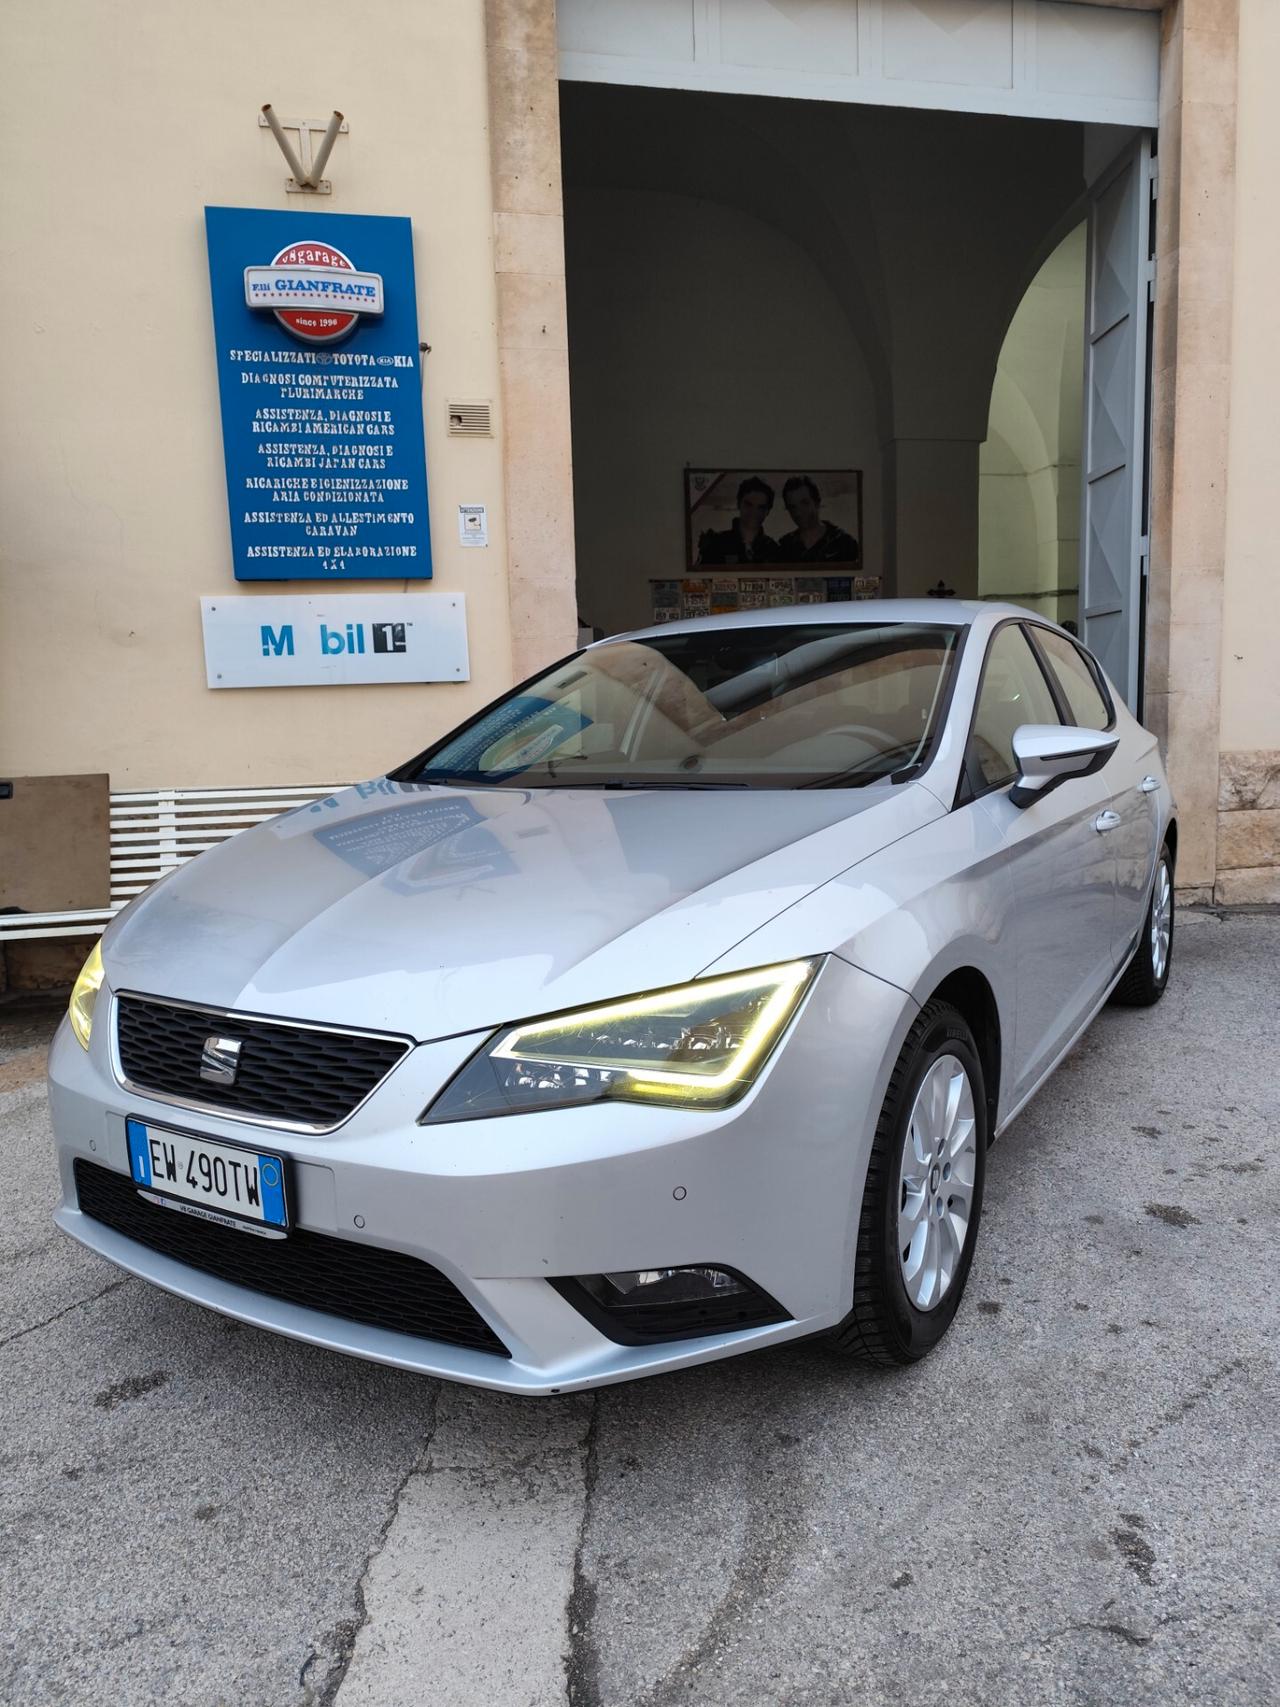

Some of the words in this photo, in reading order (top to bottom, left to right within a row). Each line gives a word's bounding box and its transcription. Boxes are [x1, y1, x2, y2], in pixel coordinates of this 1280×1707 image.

[275, 279, 376, 297] GIANFRATE
[295, 317, 317, 327] since
[230, 350, 316, 363] SPECIALIZZATI
[332, 353, 376, 366] TOYOTA
[394, 356, 414, 368] KIA
[241, 372, 296, 385] DIAGNOSI
[298, 374, 399, 388] COMPUTERIZZATA
[280, 388, 364, 400] PLURIMARCHE
[329, 410, 382, 422] DIAGNOSI
[384, 411, 391, 422] E
[252, 421, 302, 433] RICAMBI
[305, 423, 365, 435] AMERICAN
[366, 424, 395, 436] CARS
[332, 445, 384, 456] DIAGNOSI
[386, 445, 394, 456] E
[267, 456, 315, 468] RICAMBI
[318, 457, 356, 469] JAPAN
[358, 458, 386, 469] CARS
[246, 477, 309, 489] RICARICHE
[310, 478, 318, 489] E
[319, 478, 408, 490] IGIENIZZAZIONE
[272, 491, 300, 502] ARIA
[303, 491, 384, 503] CONDIZIONATA
[244, 512, 312, 524] ASSISTENZA
[315, 512, 328, 523] ED
[331, 512, 415, 524] ALLESTIMENTO
[305, 525, 358, 536] CARAVAN
[247, 546, 315, 558] ASSISTENZA
[317, 546, 331, 557] ED
[333, 546, 417, 557] ELABORAZIONE
[149, 1139, 177, 1183] EW
[186, 1150, 261, 1207] 490TW
[187, 1207, 208, 1219] GARAGE
